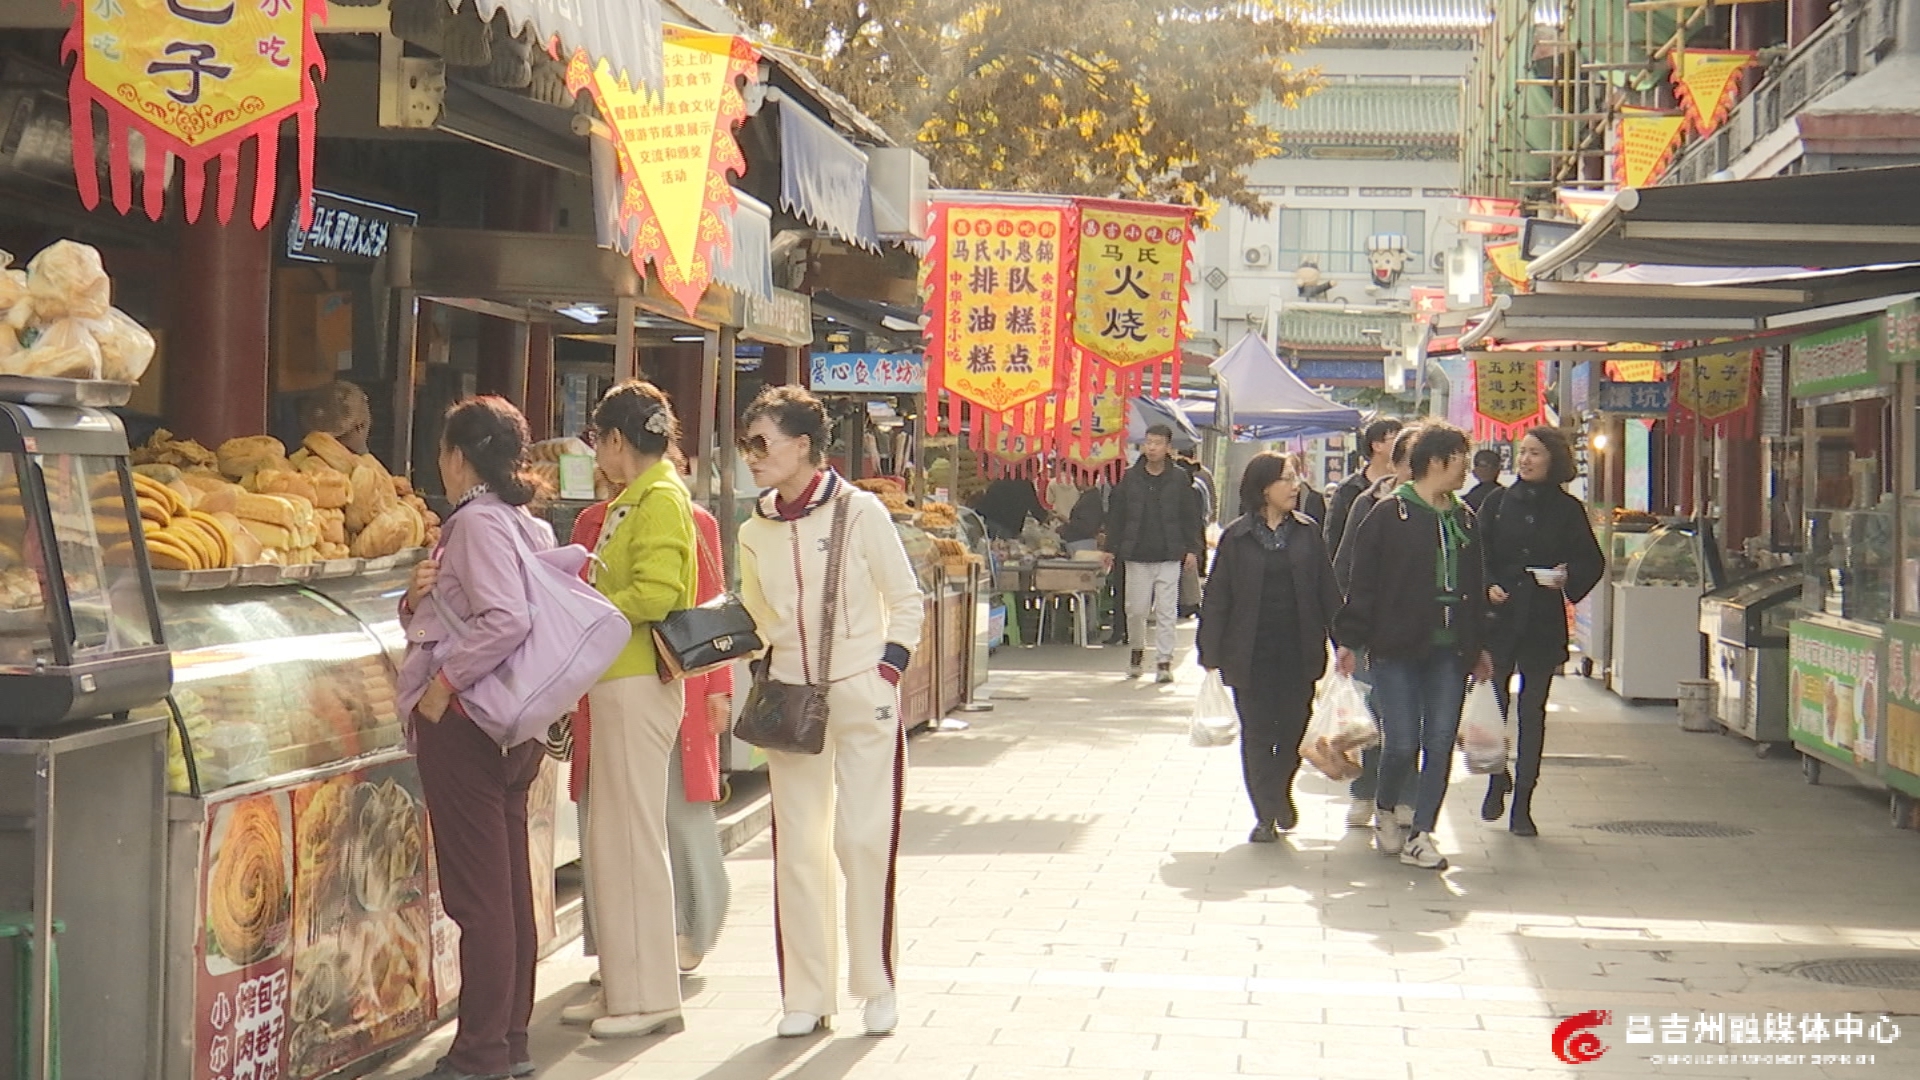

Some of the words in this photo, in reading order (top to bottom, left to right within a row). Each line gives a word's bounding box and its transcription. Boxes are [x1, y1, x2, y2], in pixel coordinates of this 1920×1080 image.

[661, 169, 687, 184] 活动
[1083, 219, 1183, 245] 昌吉小吃街
[1101, 244, 1160, 264] 马氏
[969, 265, 1038, 295] 排队
[947, 271, 962, 363] 中华名小吃
[1100, 265, 1150, 342] 火烧
[969, 305, 1037, 335] 油糕
[966, 343, 1033, 374] 糕点
